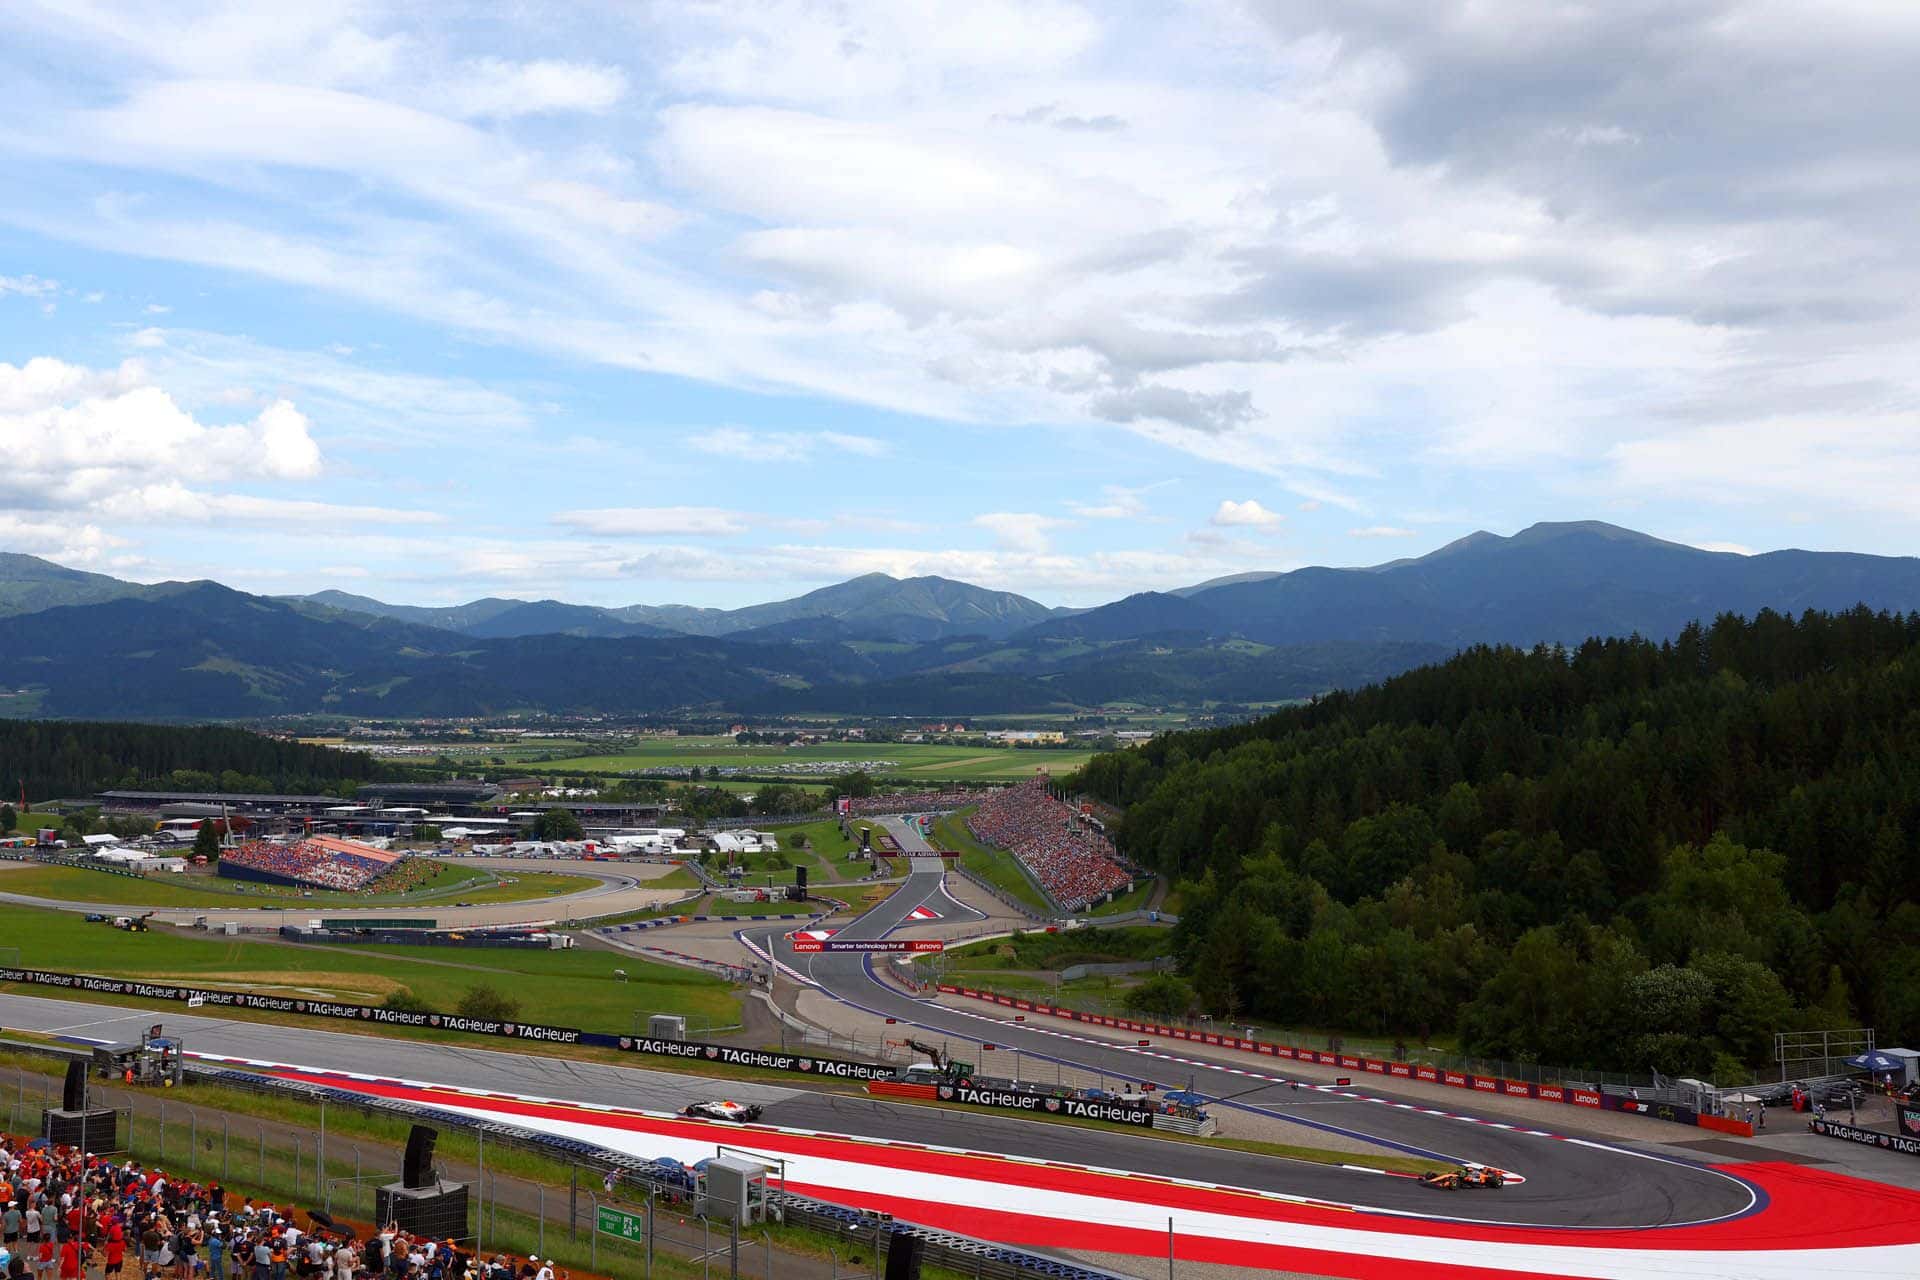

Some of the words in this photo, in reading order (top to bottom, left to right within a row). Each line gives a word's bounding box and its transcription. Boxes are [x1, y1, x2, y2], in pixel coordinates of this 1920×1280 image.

[34, 972, 72, 987] TAGHeuer
[83, 978, 124, 993] TAGHeuer
[135, 984, 176, 998] TAGHeuer
[189, 990, 234, 1004] TAGHeuer
[246, 996, 294, 1011] TAGHeuer
[308, 1002, 358, 1018] TAGHeuer
[374, 1009, 426, 1025] TAGHeuer
[443, 1016, 500, 1033] TAGHeuer
[518, 1025, 578, 1043] TAGHeuer
[634, 1039, 701, 1057] TAGHeuer
[722, 1049, 794, 1070] TAGHeuer
[816, 1060, 897, 1081] TAGHeuer
[1445, 1073, 1464, 1085] Lenovo
[1475, 1079, 1496, 1090] Lenovo
[1506, 1083, 1528, 1095] Lenovo
[1539, 1088, 1562, 1100] Lenovo
[958, 1088, 1040, 1109] TAGHeuer
[1575, 1092, 1598, 1105] Lenovo
[1064, 1100, 1150, 1124] TAGHeuer
[1826, 1124, 1878, 1144] TAGHeuer
